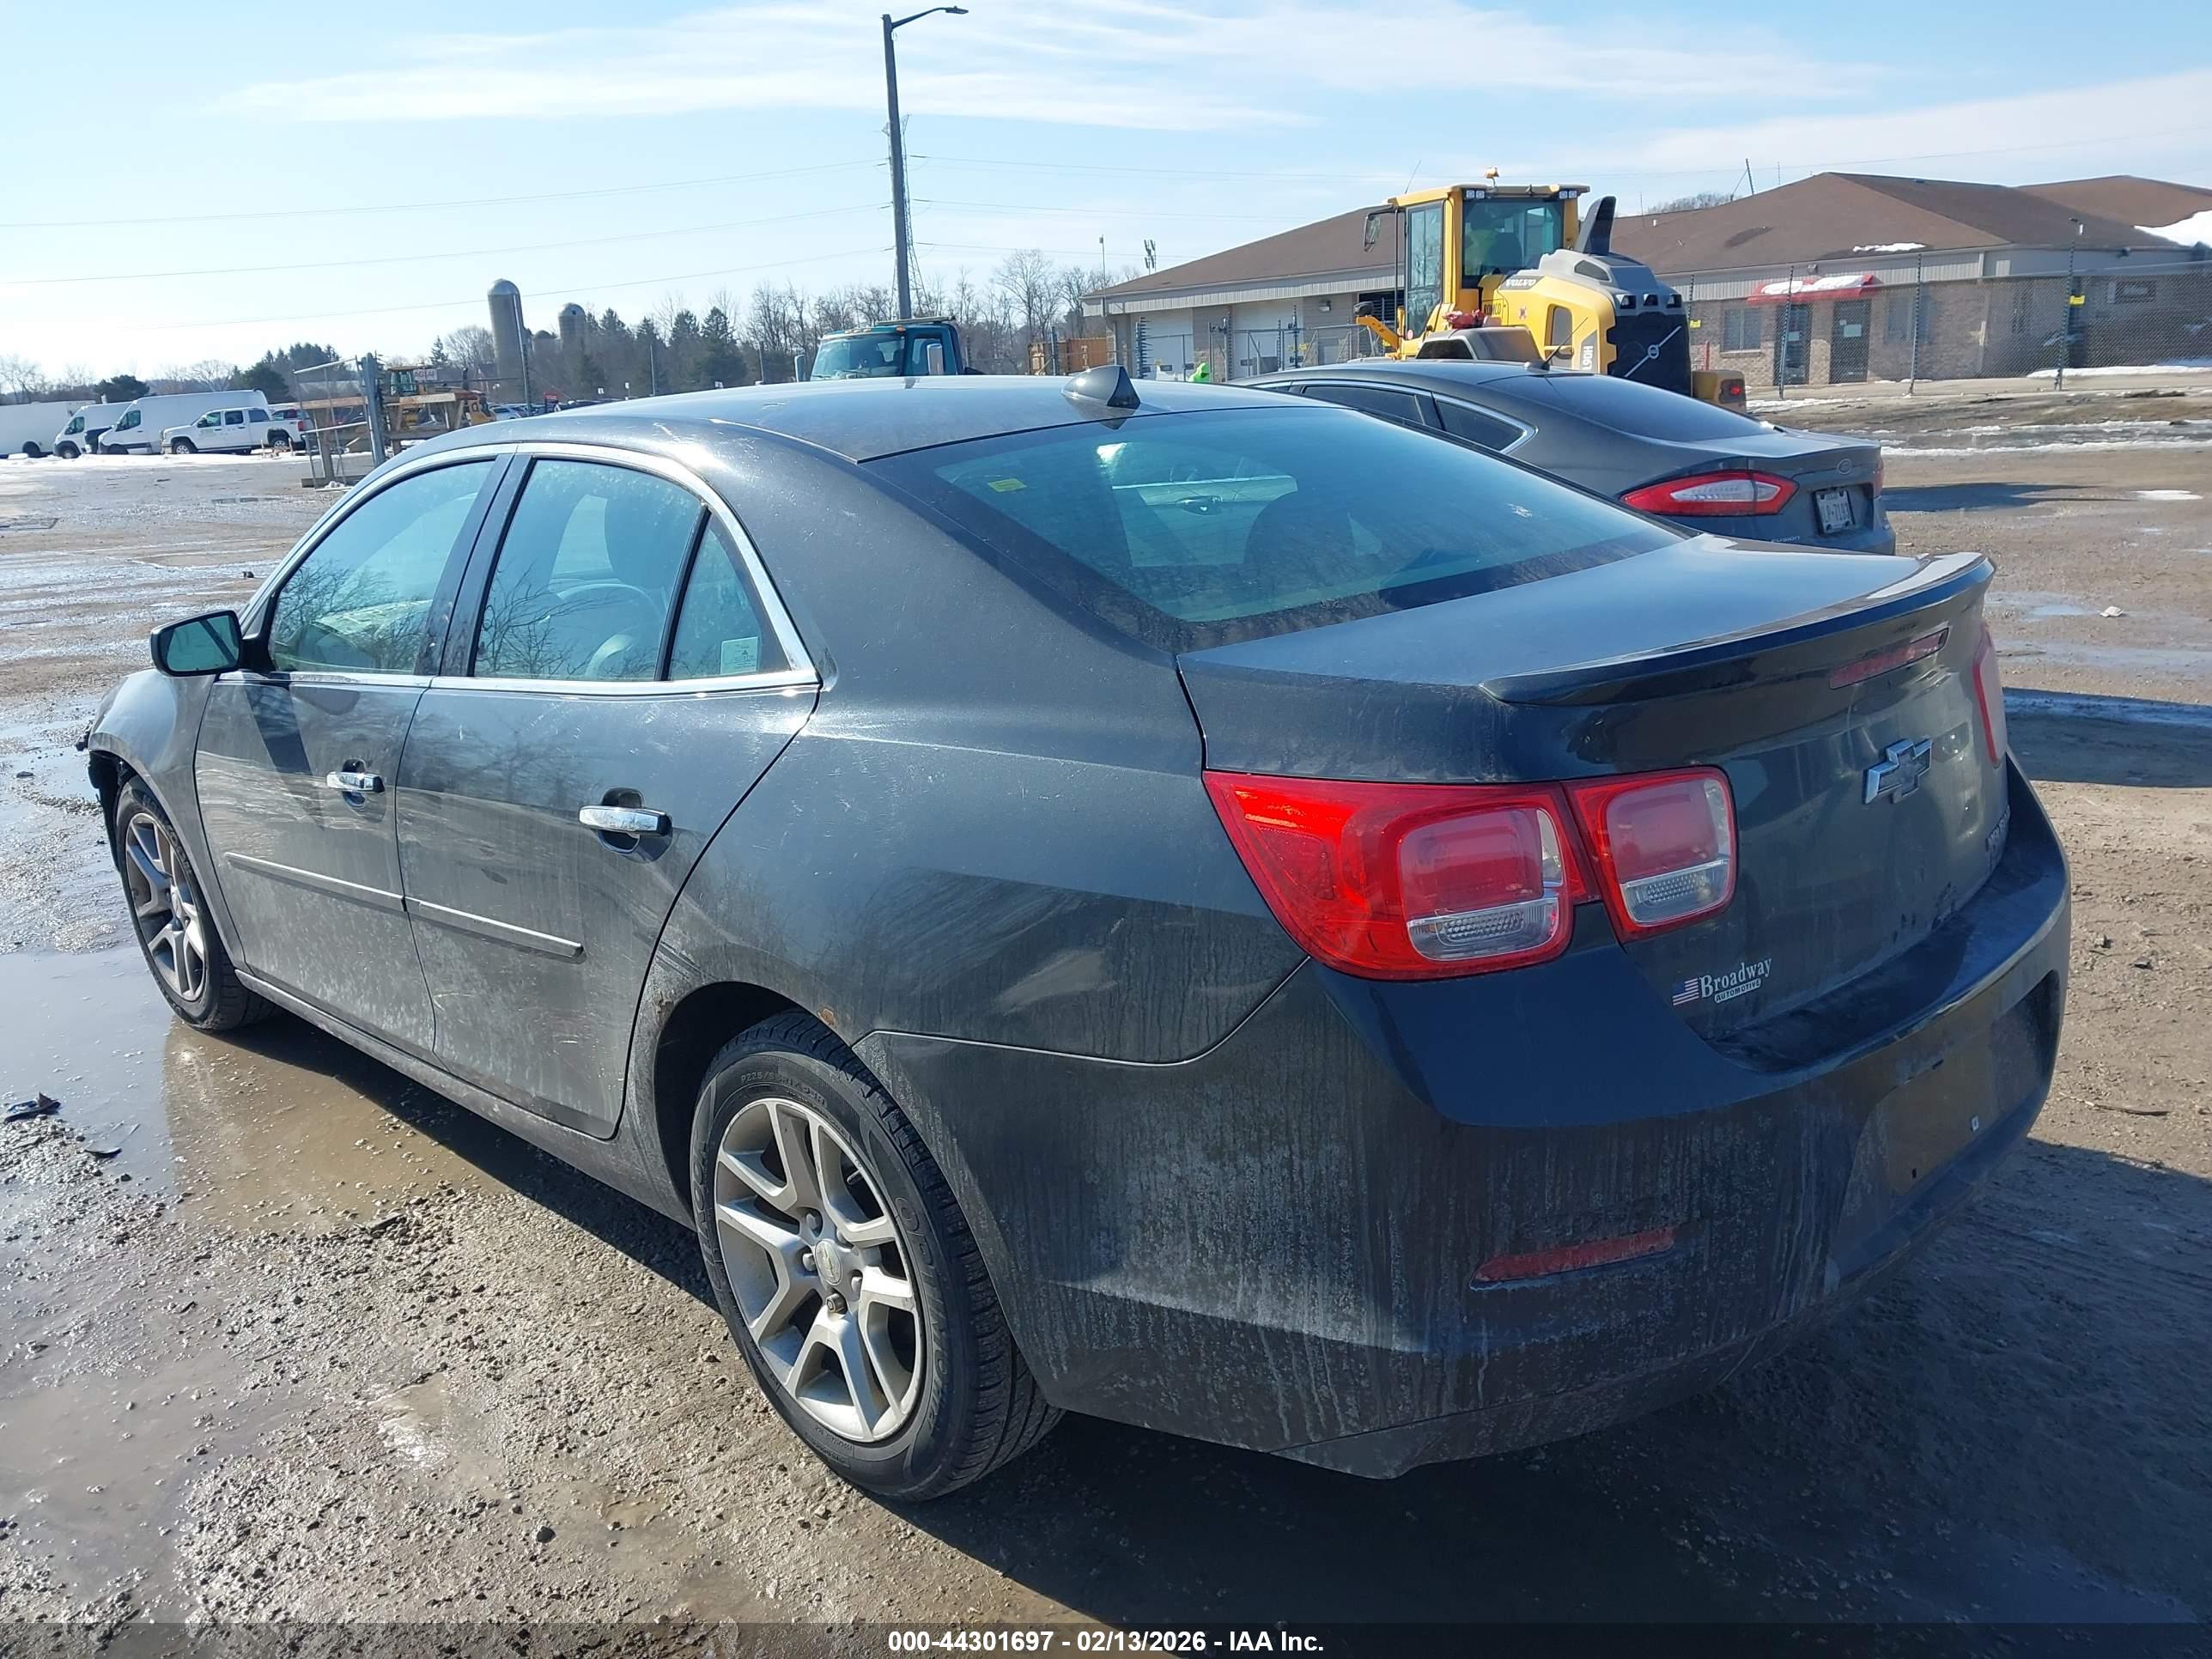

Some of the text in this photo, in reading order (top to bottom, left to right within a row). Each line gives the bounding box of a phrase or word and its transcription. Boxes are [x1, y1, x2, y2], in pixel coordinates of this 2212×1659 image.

[1505, 279, 1537, 288] VOLVO
[1699, 957, 1772, 998] Broadway
[1716, 980, 1760, 1003] AUTOMOTIVE
